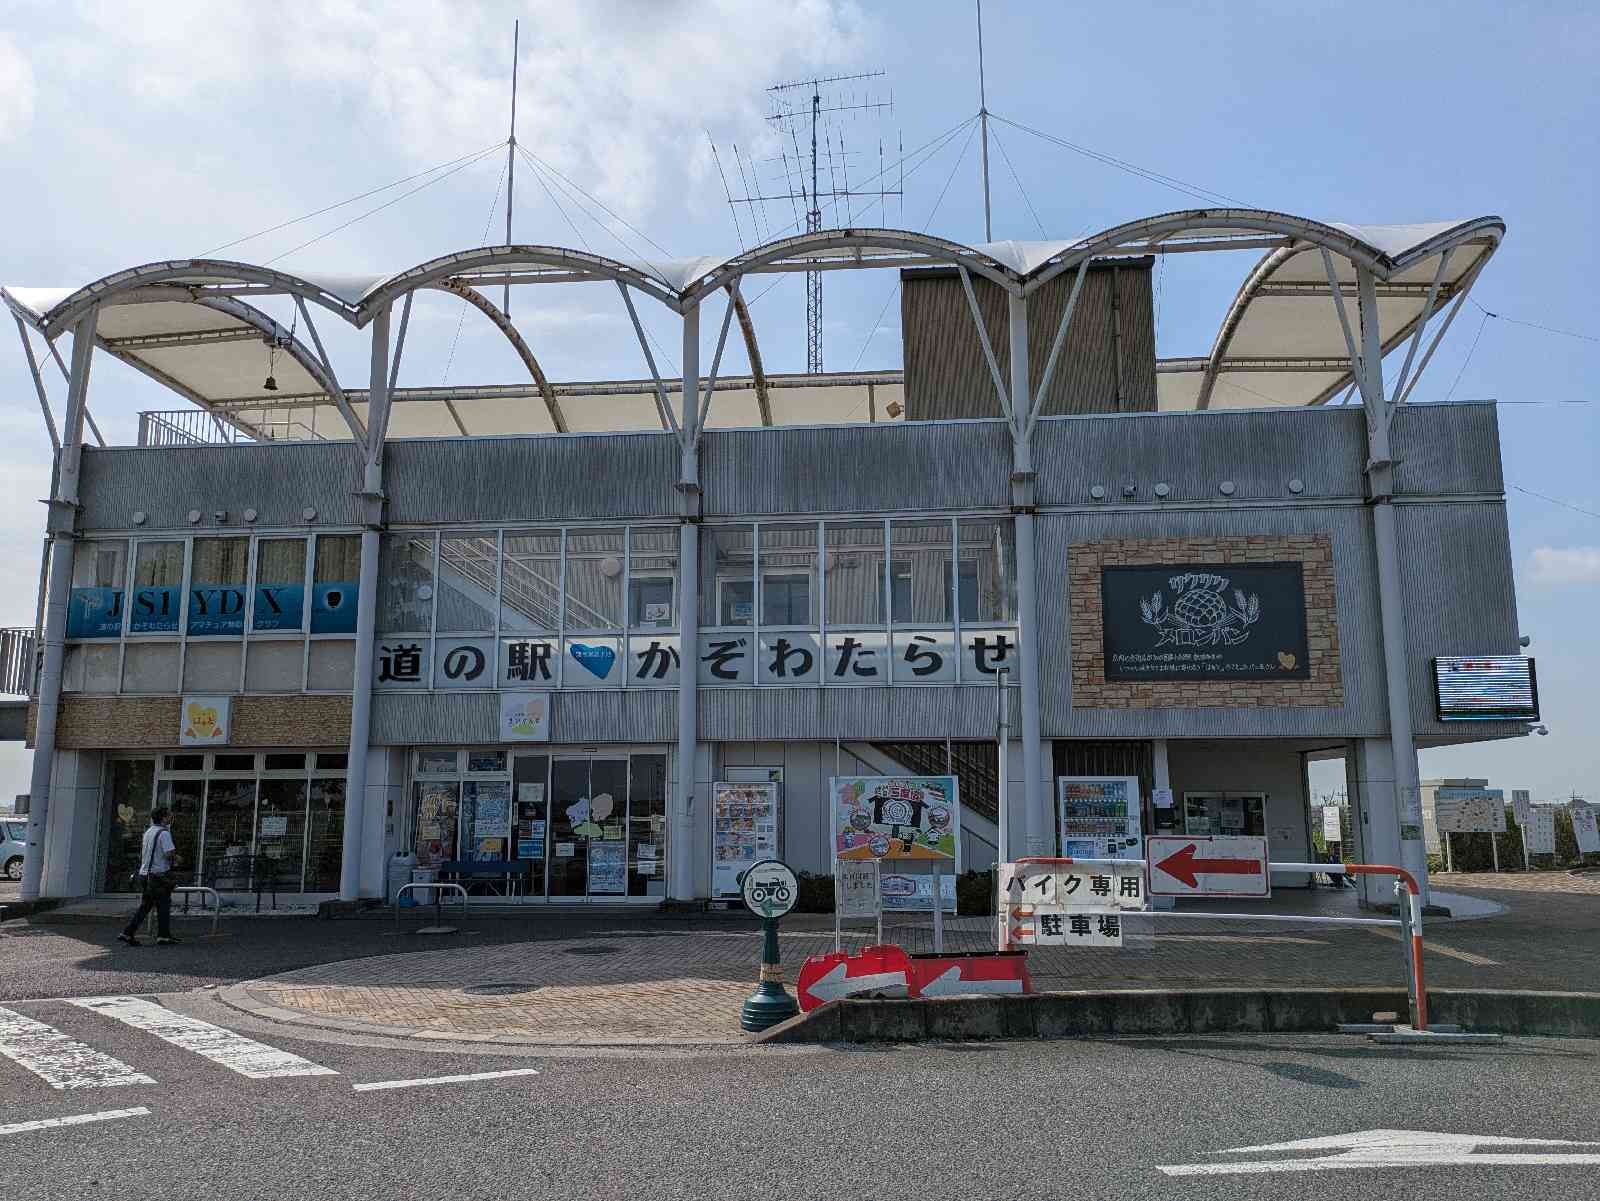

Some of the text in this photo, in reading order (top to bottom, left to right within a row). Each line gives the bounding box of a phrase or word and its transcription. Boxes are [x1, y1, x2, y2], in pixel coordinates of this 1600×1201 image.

[378, 634, 1015, 683] 道の駅 かぞわたらせ
[1006, 874, 1140, 898] バイク専用
[1040, 913, 1121, 938] 駐車場
